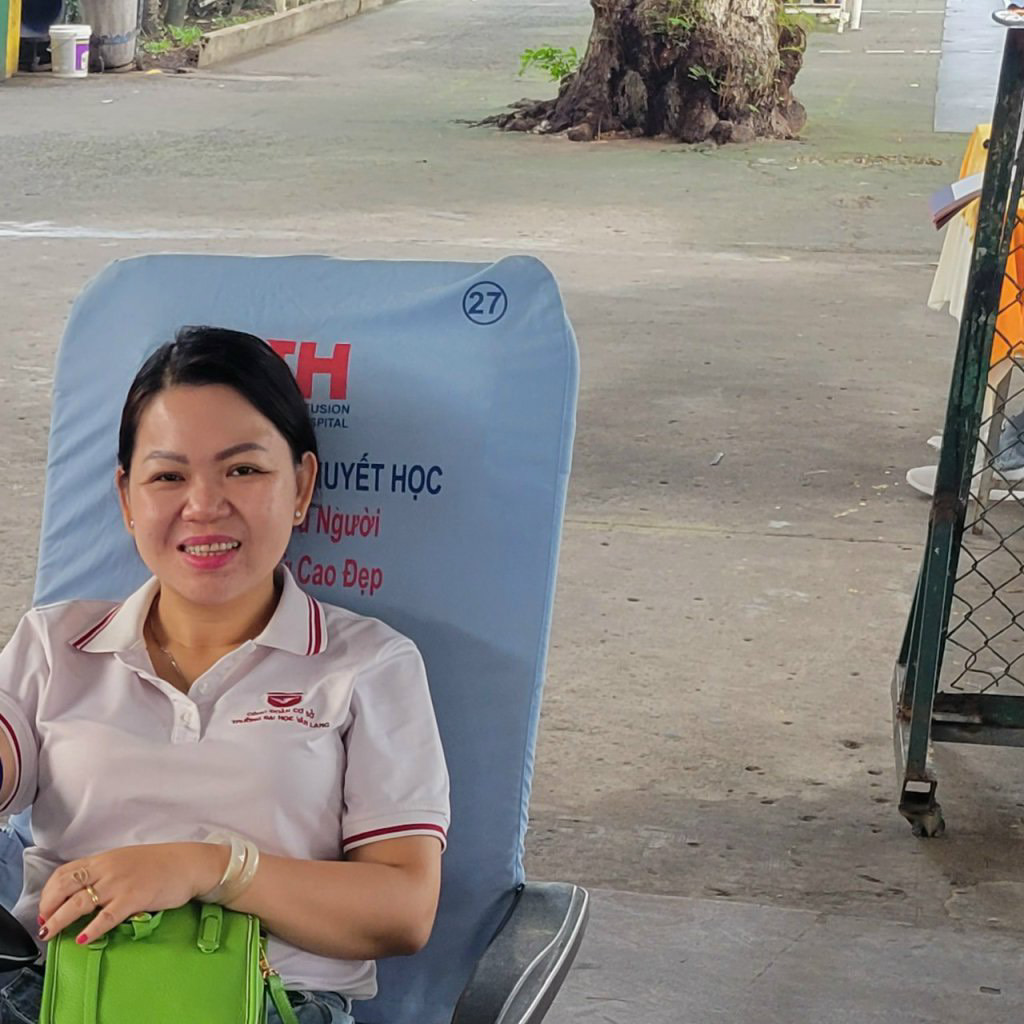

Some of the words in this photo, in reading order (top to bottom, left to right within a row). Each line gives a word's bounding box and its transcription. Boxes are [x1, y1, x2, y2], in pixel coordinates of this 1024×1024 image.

[467, 291, 503, 315] 27
[308, 403, 350, 415] USION
[391, 463, 444, 501] HỌC
[316, 505, 381, 544] Người
[297, 554, 337, 587] Cao
[342, 558, 383, 596] Đẹp
